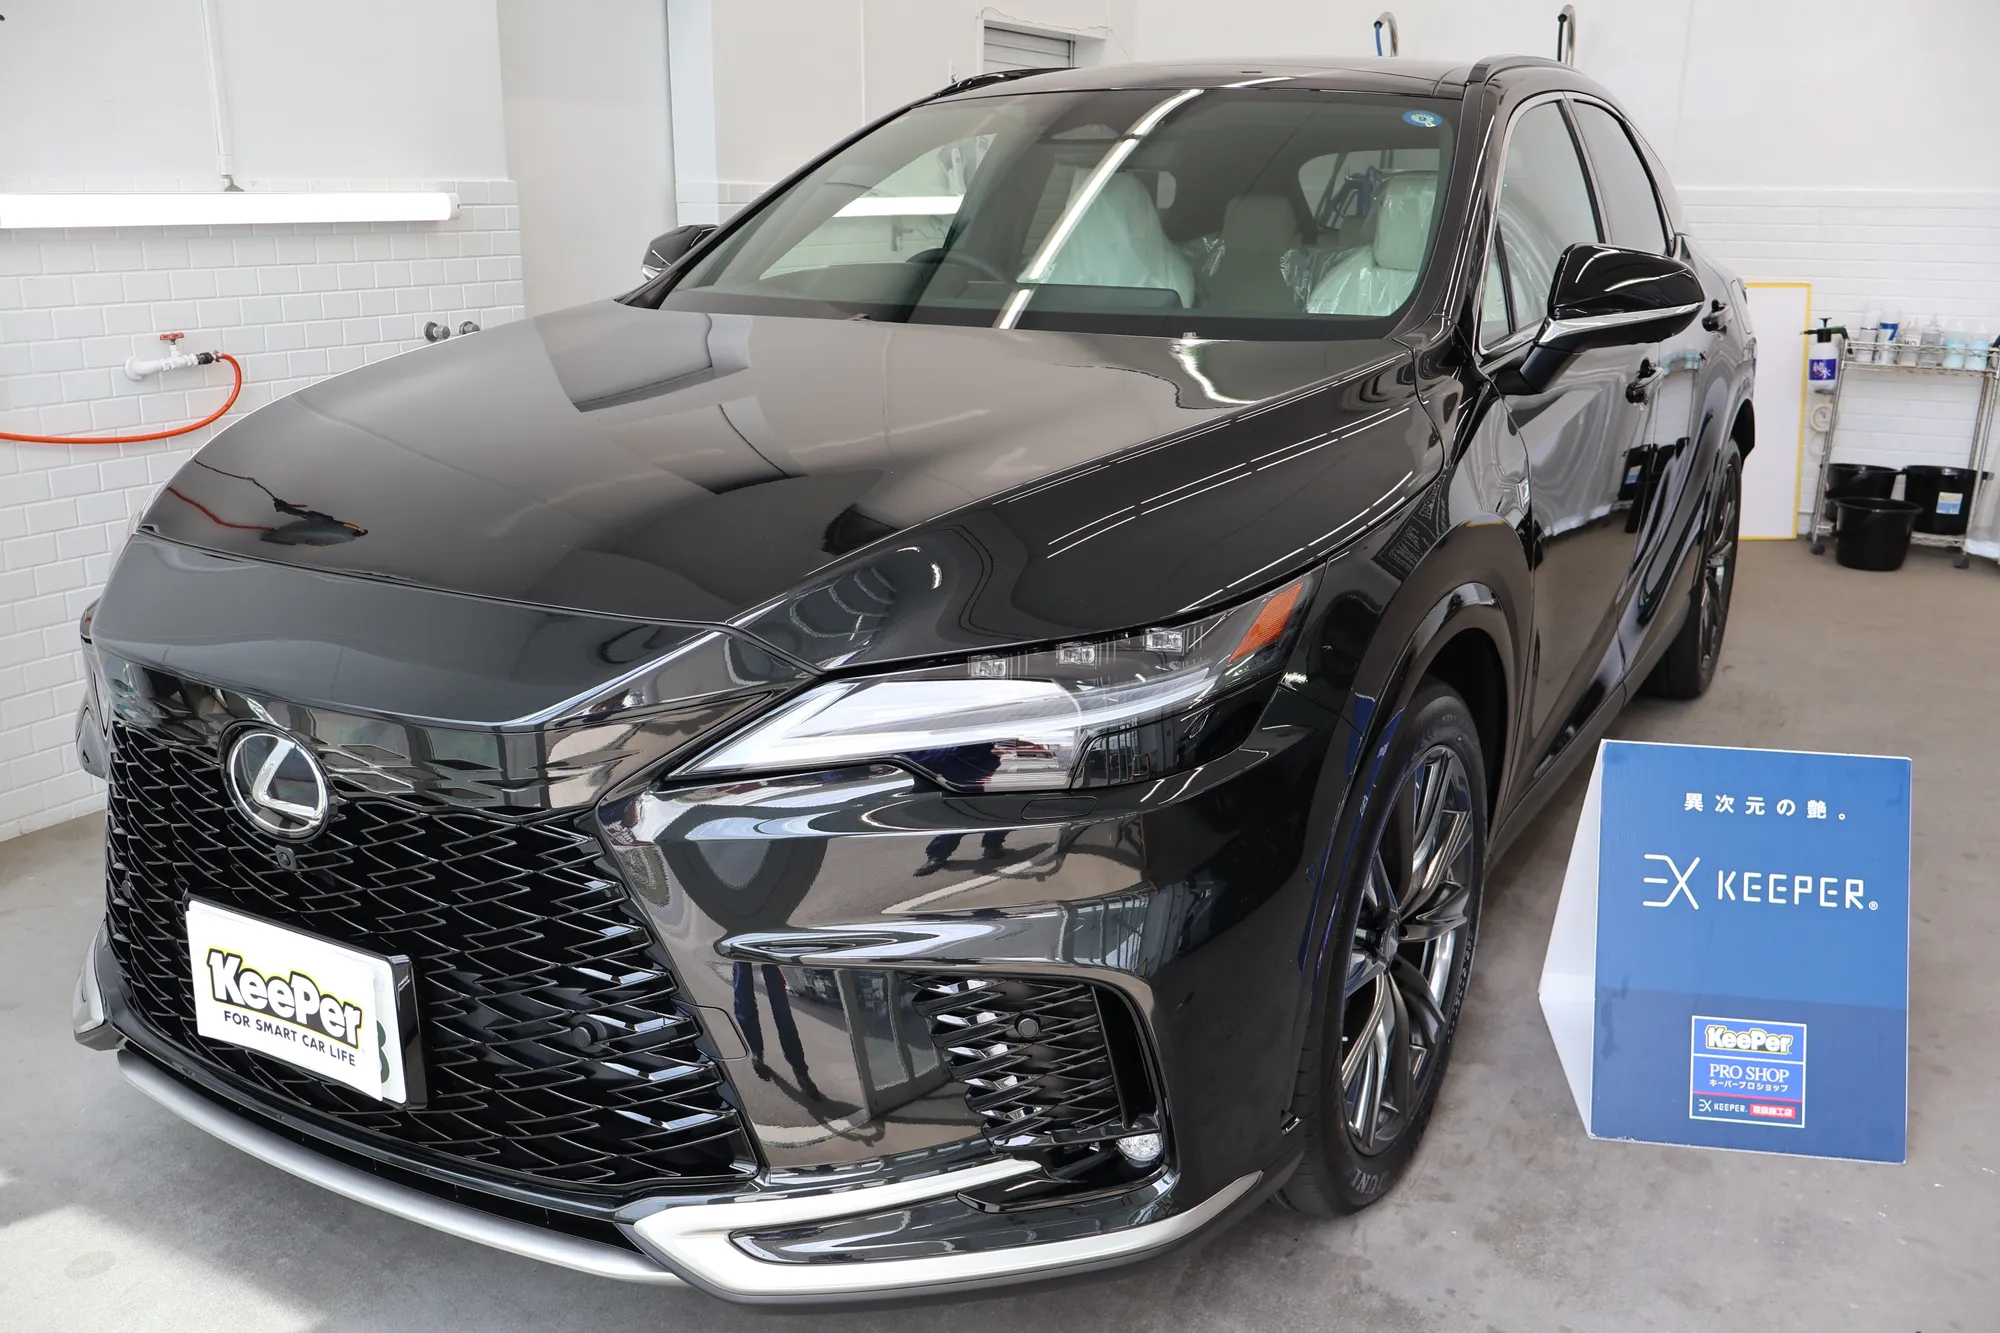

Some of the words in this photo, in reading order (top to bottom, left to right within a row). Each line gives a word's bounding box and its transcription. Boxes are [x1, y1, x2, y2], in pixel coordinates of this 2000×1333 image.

[1684, 792, 1846, 820] 異次元の艶。
[207, 948, 362, 1049] KeePer
[224, 1010, 250, 1027] FOR
[255, 1020, 298, 1042] SMART
[302, 1034, 326, 1054] CAR
[329, 1045, 356, 1067] LIFE
[1705, 1025, 1793, 1054] KeePer
[1709, 1063, 1743, 1080] PRO
[1745, 1066, 1790, 1083] SHOP
[1709, 1079, 1789, 1092] キーパープロショップ
